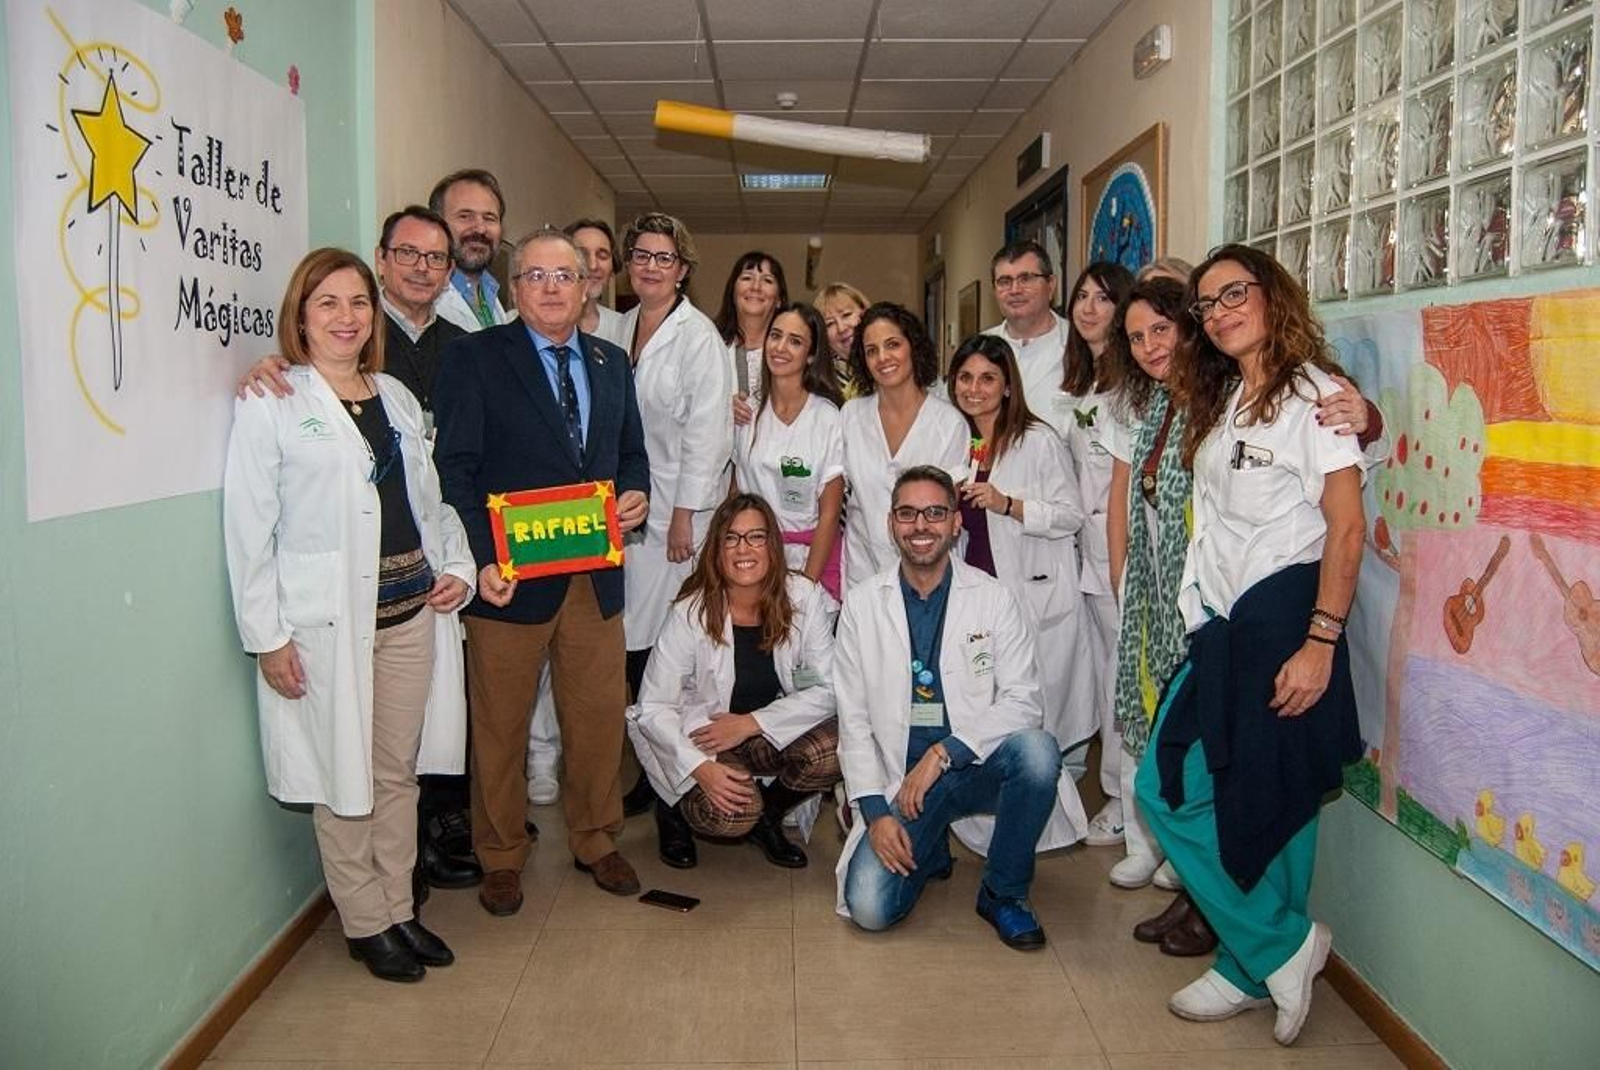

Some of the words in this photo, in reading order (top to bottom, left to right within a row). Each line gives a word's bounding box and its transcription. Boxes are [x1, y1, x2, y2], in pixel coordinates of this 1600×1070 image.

[171, 116, 250, 200] Taller
[256, 160, 282, 214] de
[173, 196, 262, 272] Varitas
[174, 275, 274, 347] Mágicas
[513, 513, 606, 543] RAFAEL
